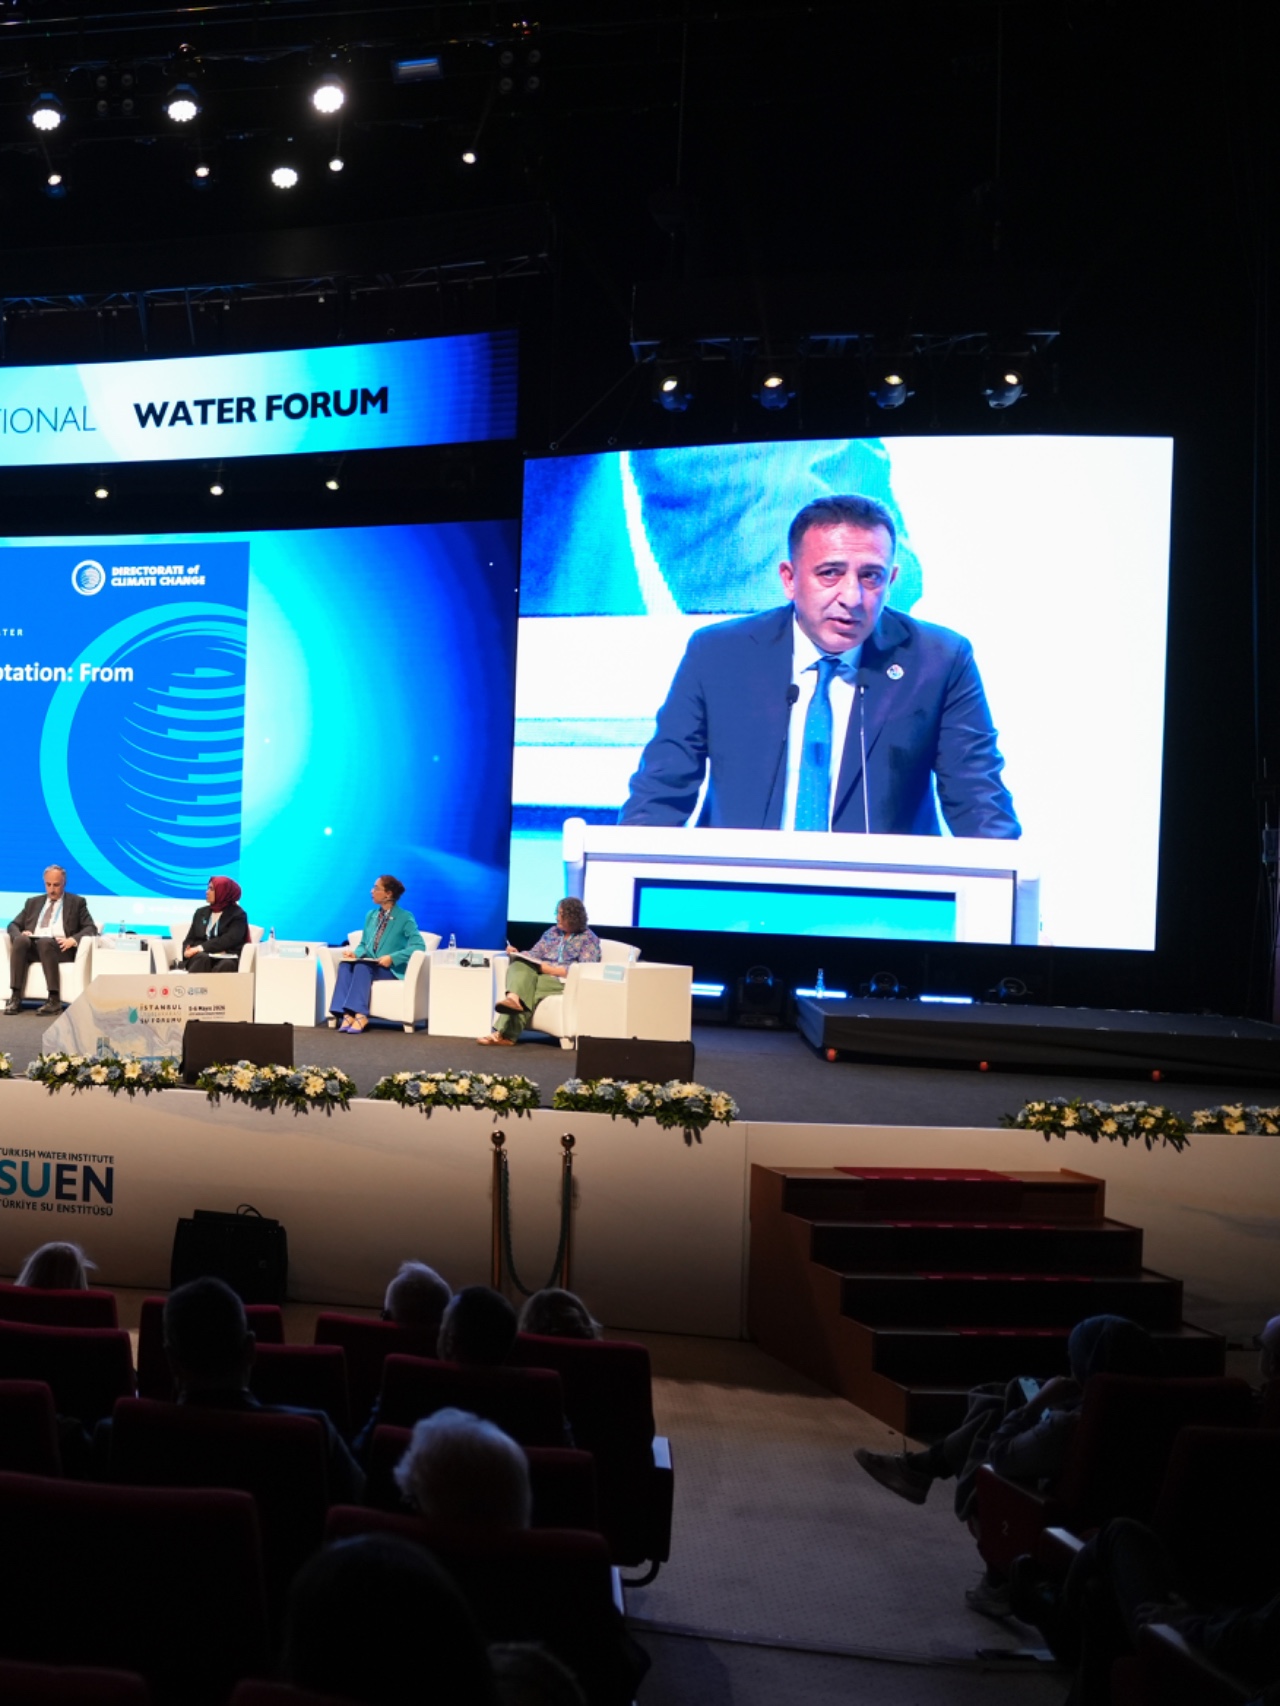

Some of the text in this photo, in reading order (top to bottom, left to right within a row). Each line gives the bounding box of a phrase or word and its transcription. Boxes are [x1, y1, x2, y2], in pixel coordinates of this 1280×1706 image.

[133, 396, 257, 429] WATER
[265, 386, 389, 421] FORUM
[111, 564, 200, 576] DIRECTORATE of
[111, 575, 206, 586] CLIMATE CHANGE
[80, 663, 134, 682] From
[37, 1150, 67, 1161] WATER
[68, 1153, 114, 1164] INSTITUTE
[40, 1201, 53, 1212] SU
[56, 1202, 113, 1216] ENSTİTÜSÜ
